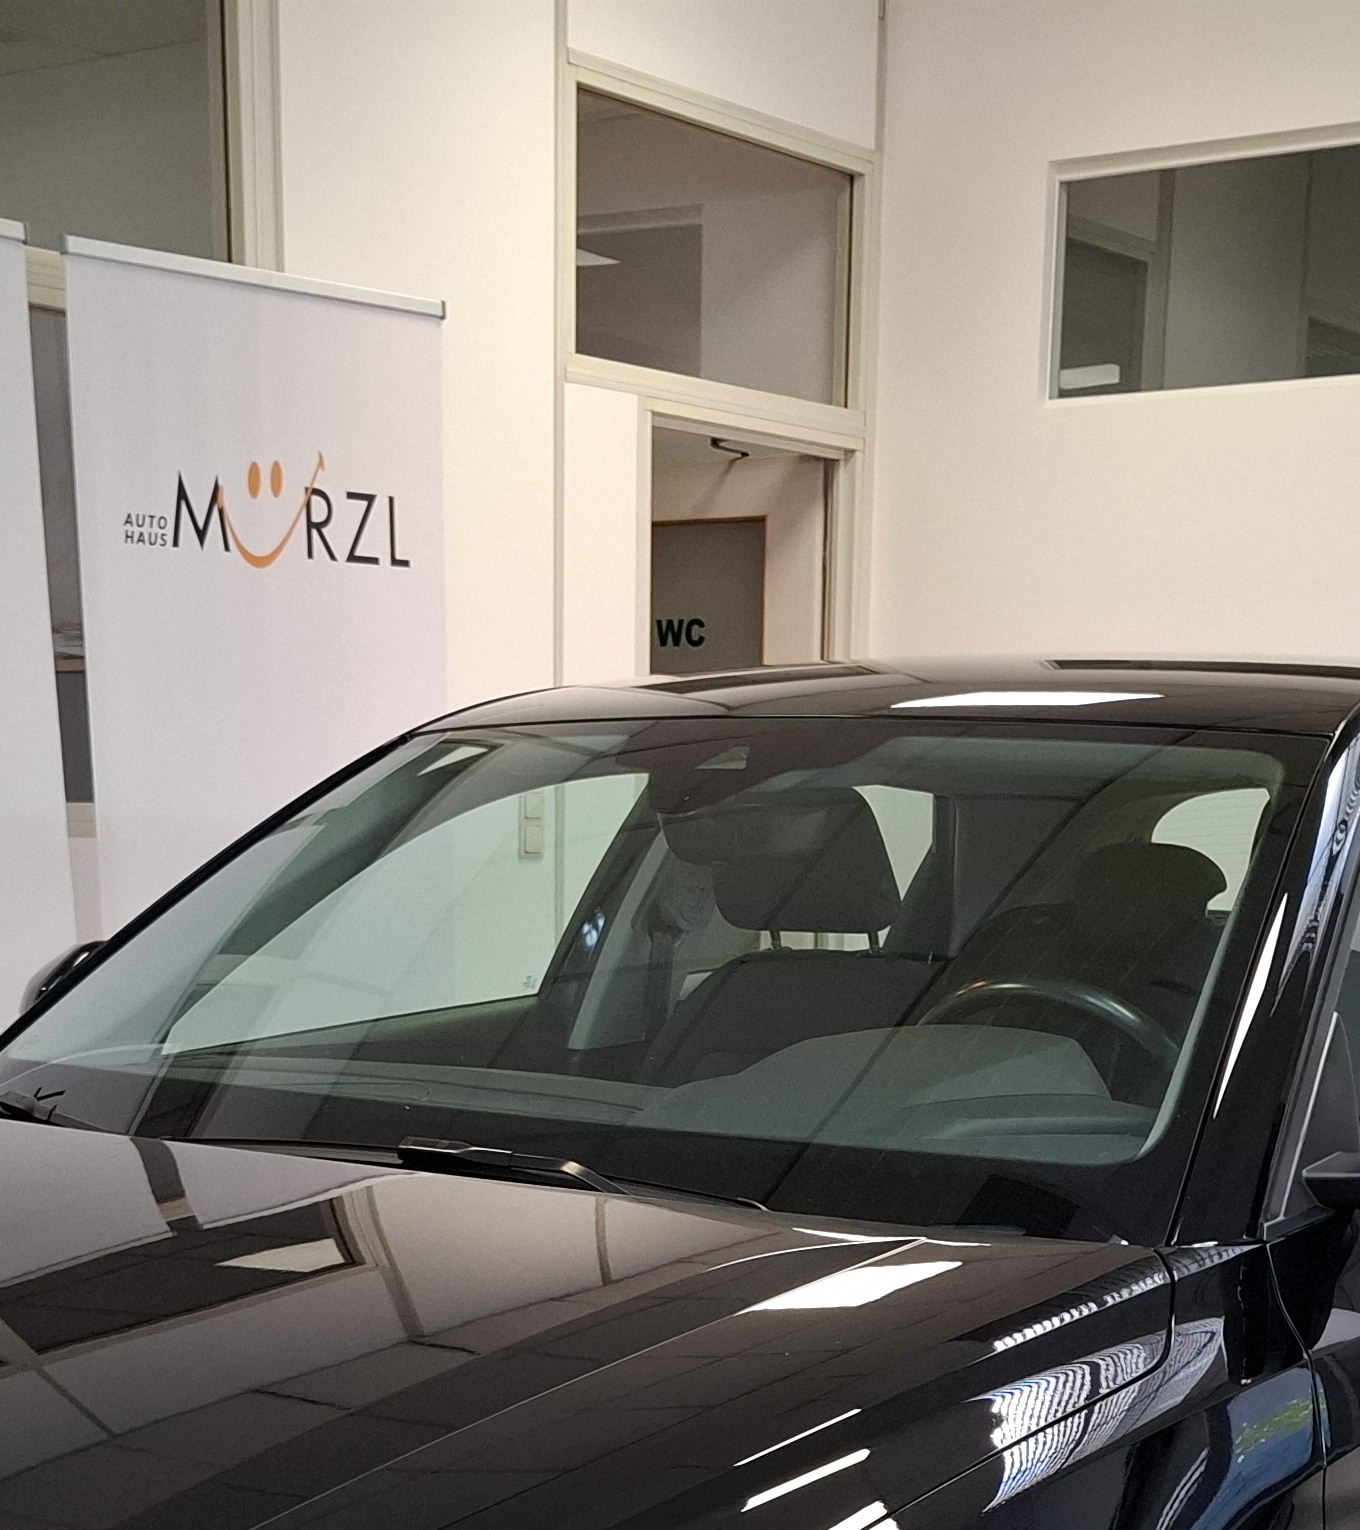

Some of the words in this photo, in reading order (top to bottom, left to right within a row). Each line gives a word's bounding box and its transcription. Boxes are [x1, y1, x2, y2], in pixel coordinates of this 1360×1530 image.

[123, 513, 168, 530] AUTO
[124, 530, 168, 547] HAUS
[656, 618, 706, 648] WC
